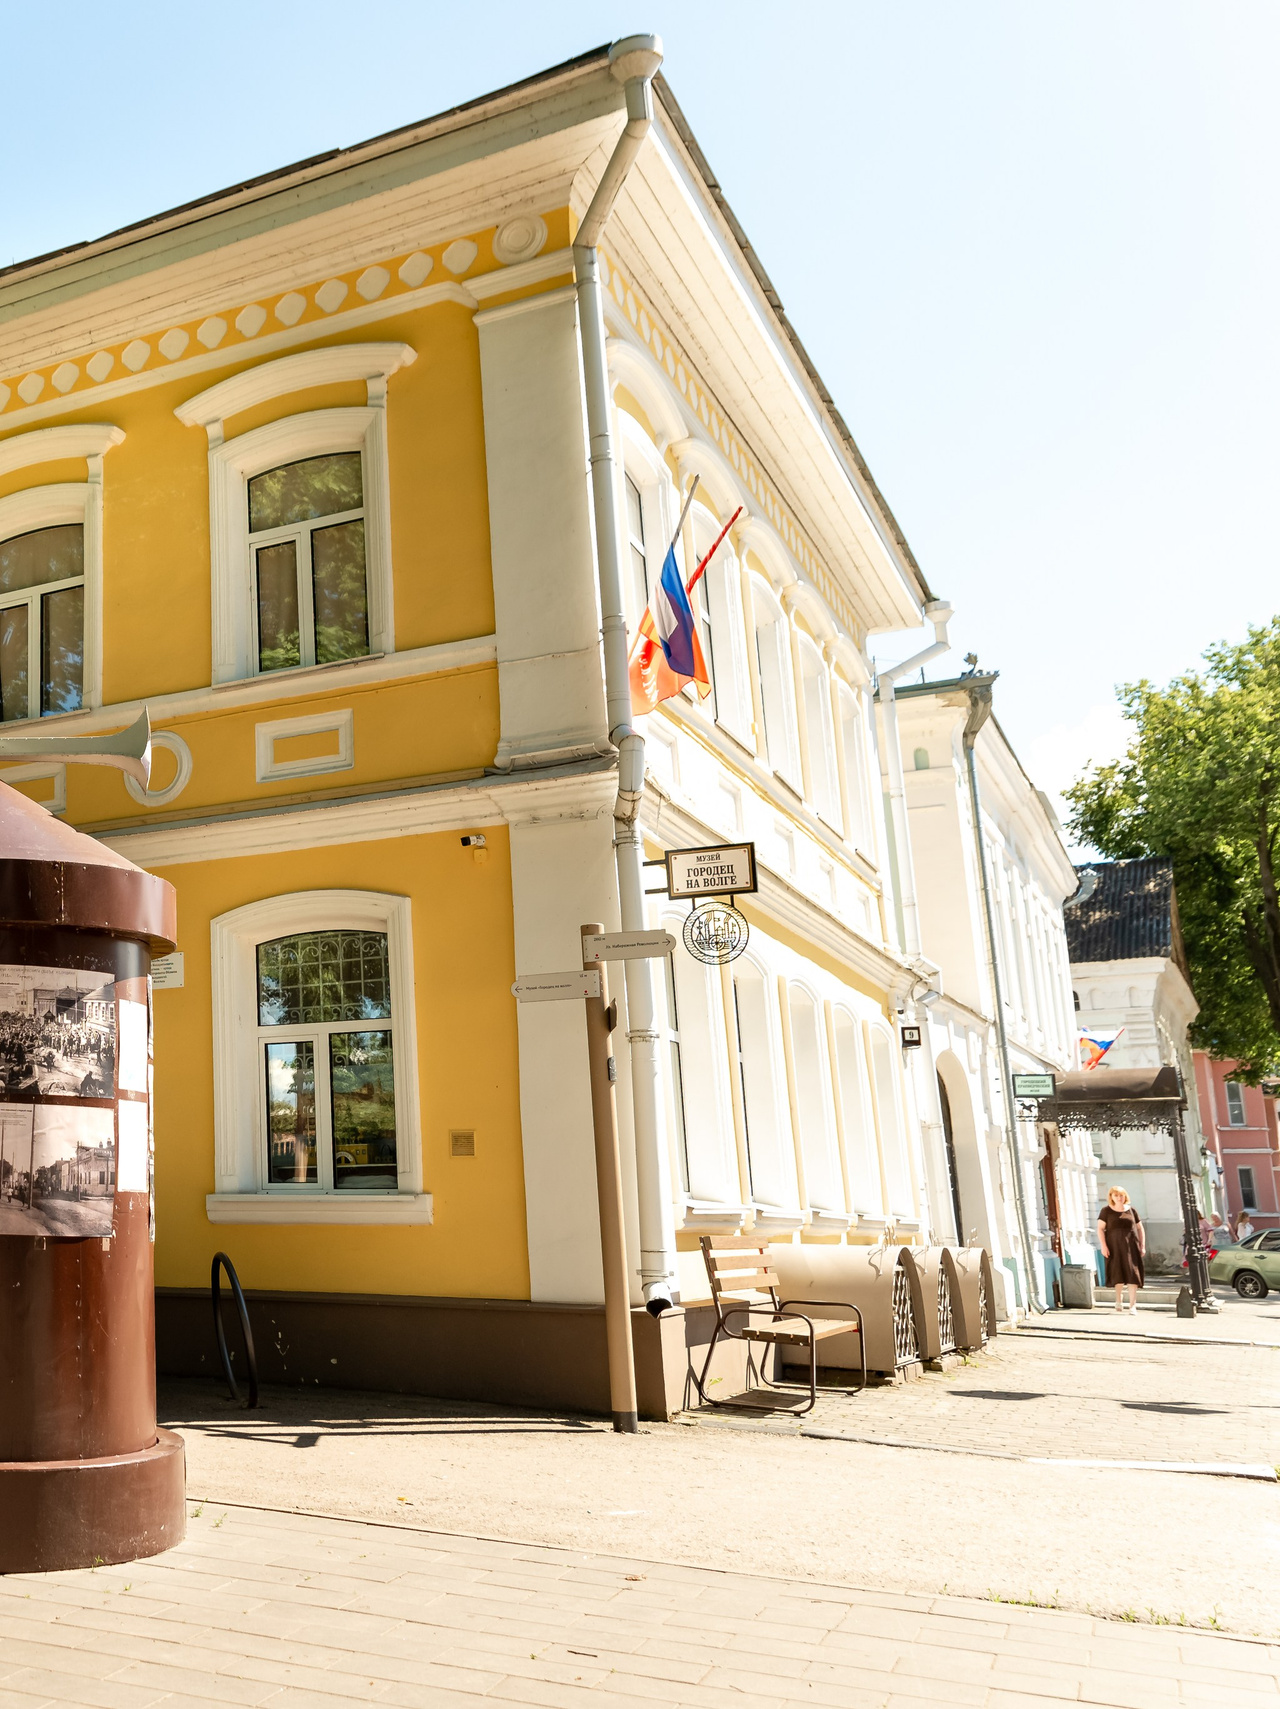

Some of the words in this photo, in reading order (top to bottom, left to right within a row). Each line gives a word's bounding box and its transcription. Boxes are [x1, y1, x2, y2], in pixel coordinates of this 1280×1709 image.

[696, 853, 721, 862] МУЗЕЙ
[687, 864, 735, 877] ГОРОДЕЦ
[686, 879, 700, 888] НА
[703, 876, 737, 887] ВОЛГЕ
[909, 1031, 914, 1039] 9
